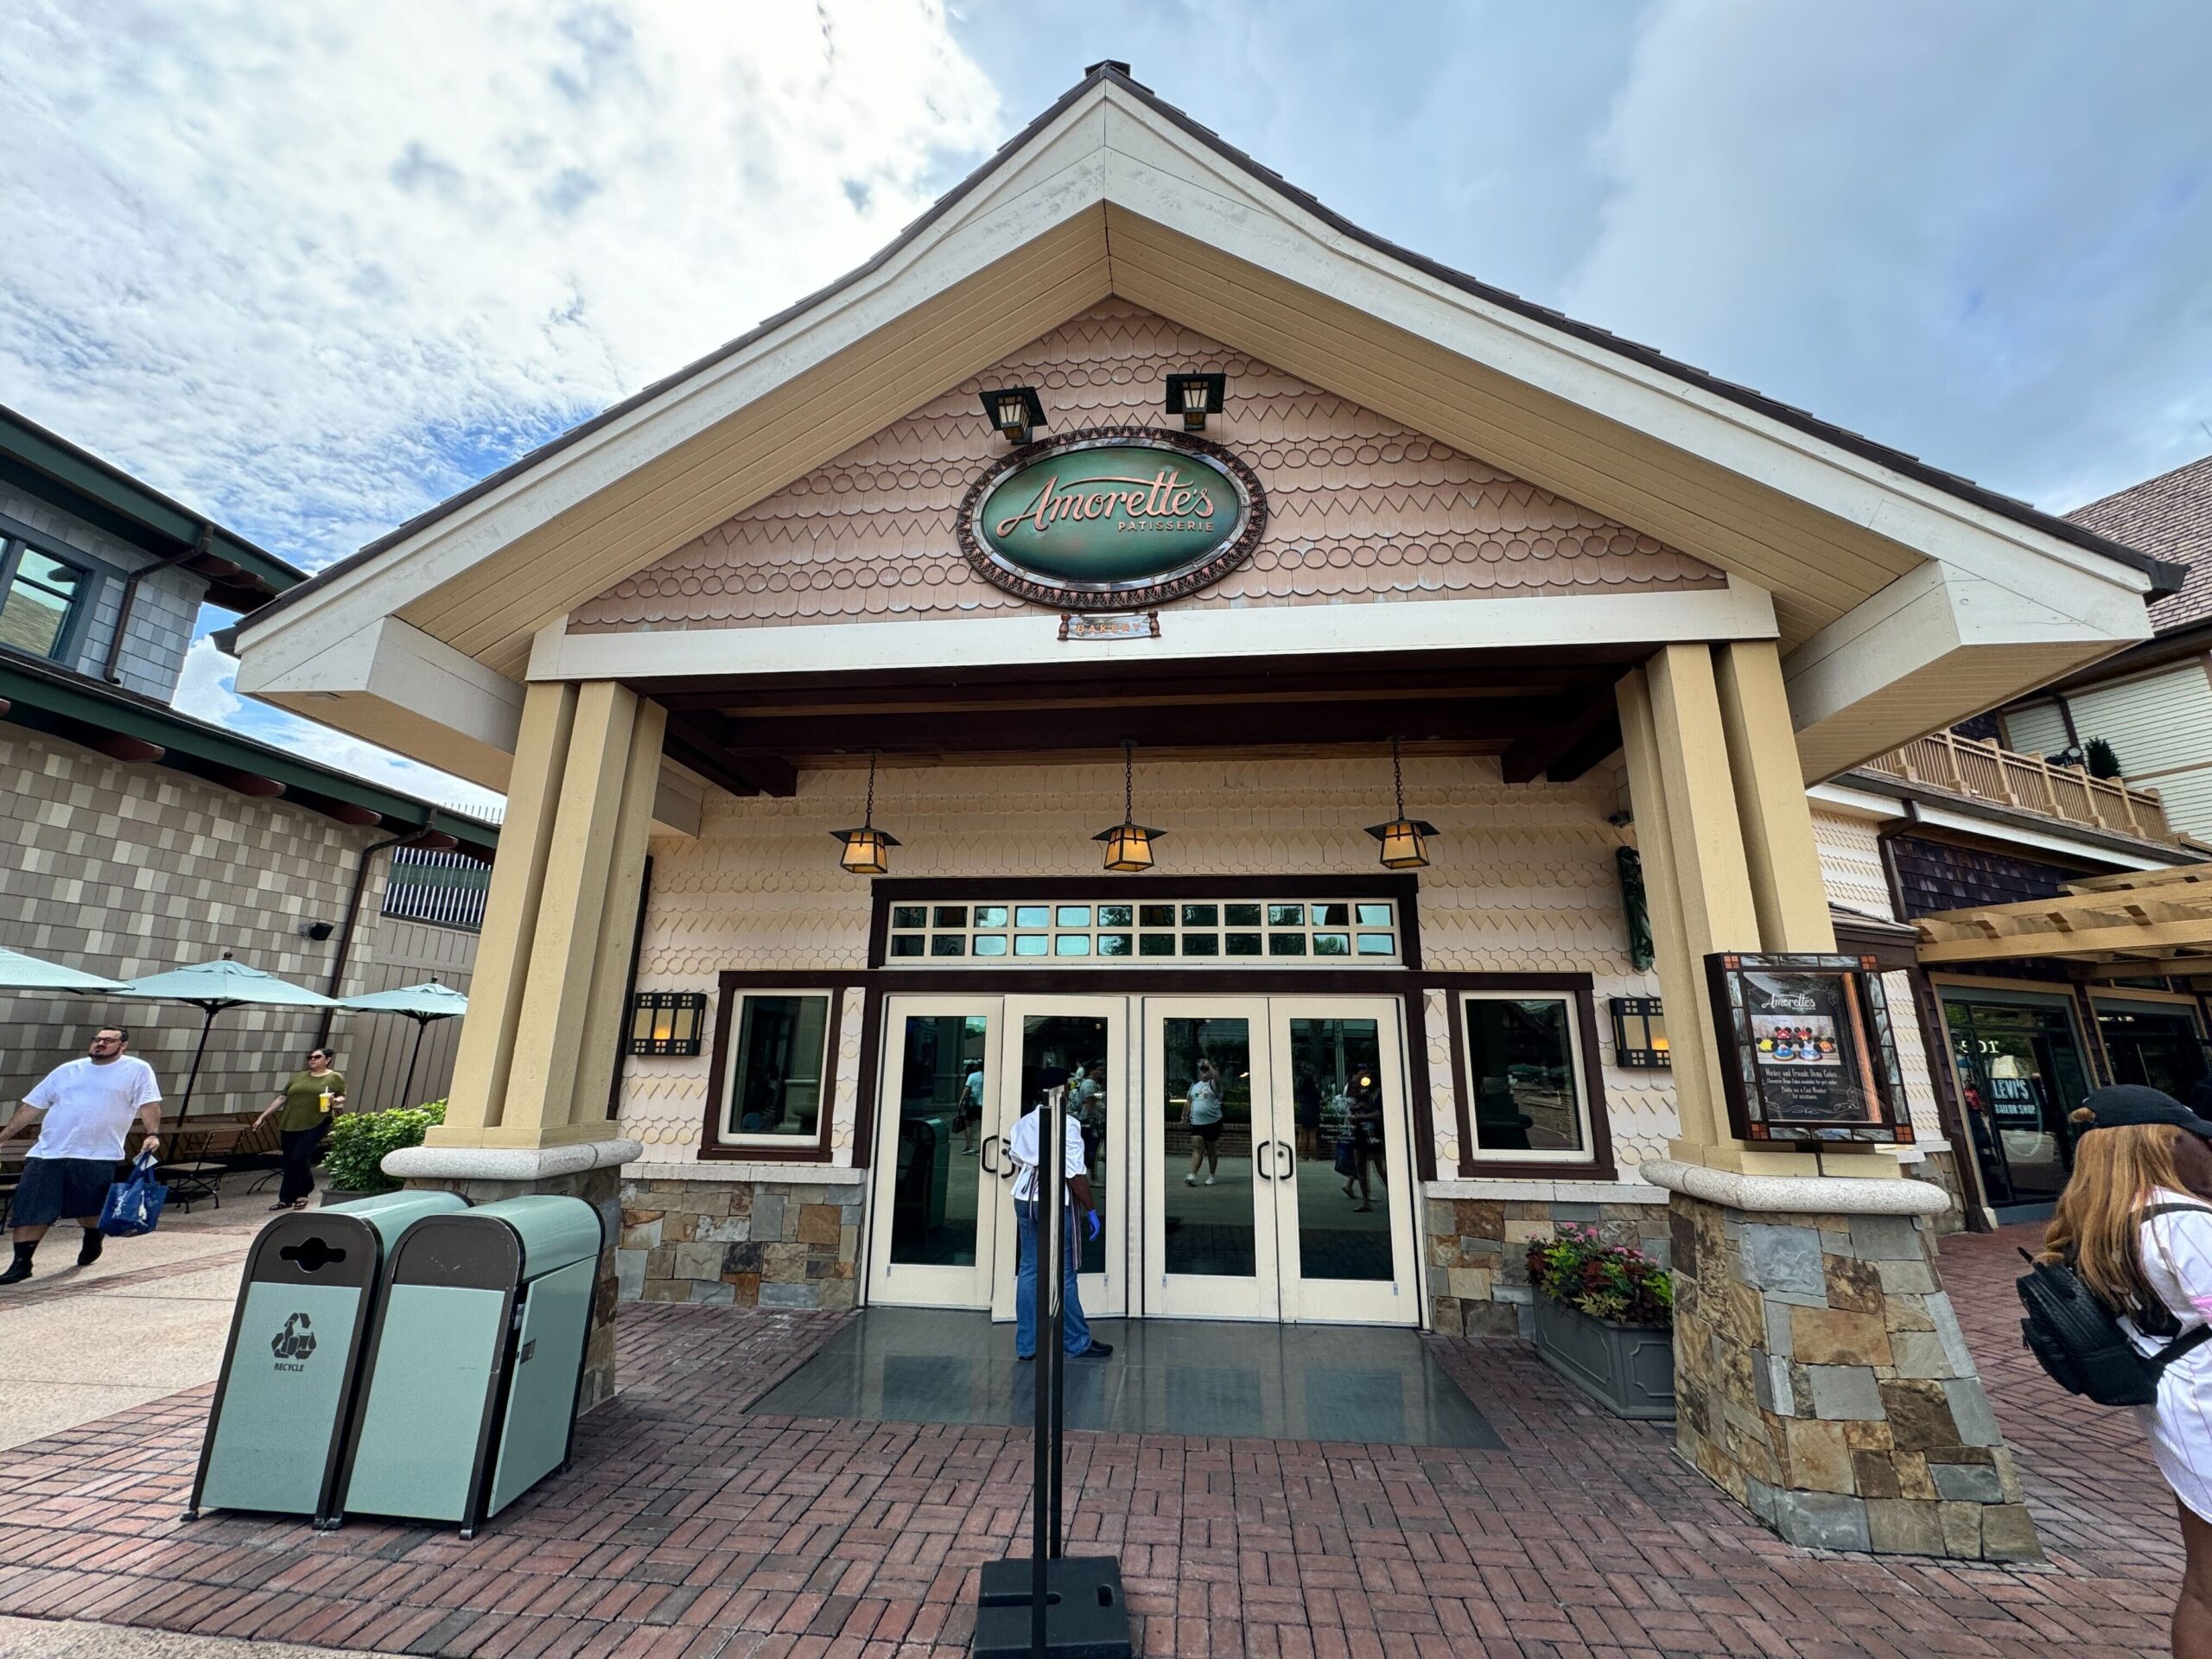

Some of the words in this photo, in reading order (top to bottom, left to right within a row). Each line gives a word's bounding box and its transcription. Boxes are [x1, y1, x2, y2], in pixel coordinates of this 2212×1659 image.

[996, 471, 1214, 537] Amorette's
[1118, 521, 1214, 532] PATISSERIE
[1077, 623, 1140, 632] BAKERY
[1783, 1068, 1791, 1077] and
[1992, 1078, 2029, 1100] LEVI'S
[1993, 1103, 2018, 1115] TAILOR
[2018, 1103, 2036, 1115] SHOP
[274, 1363, 304, 1372] RECYCLE
